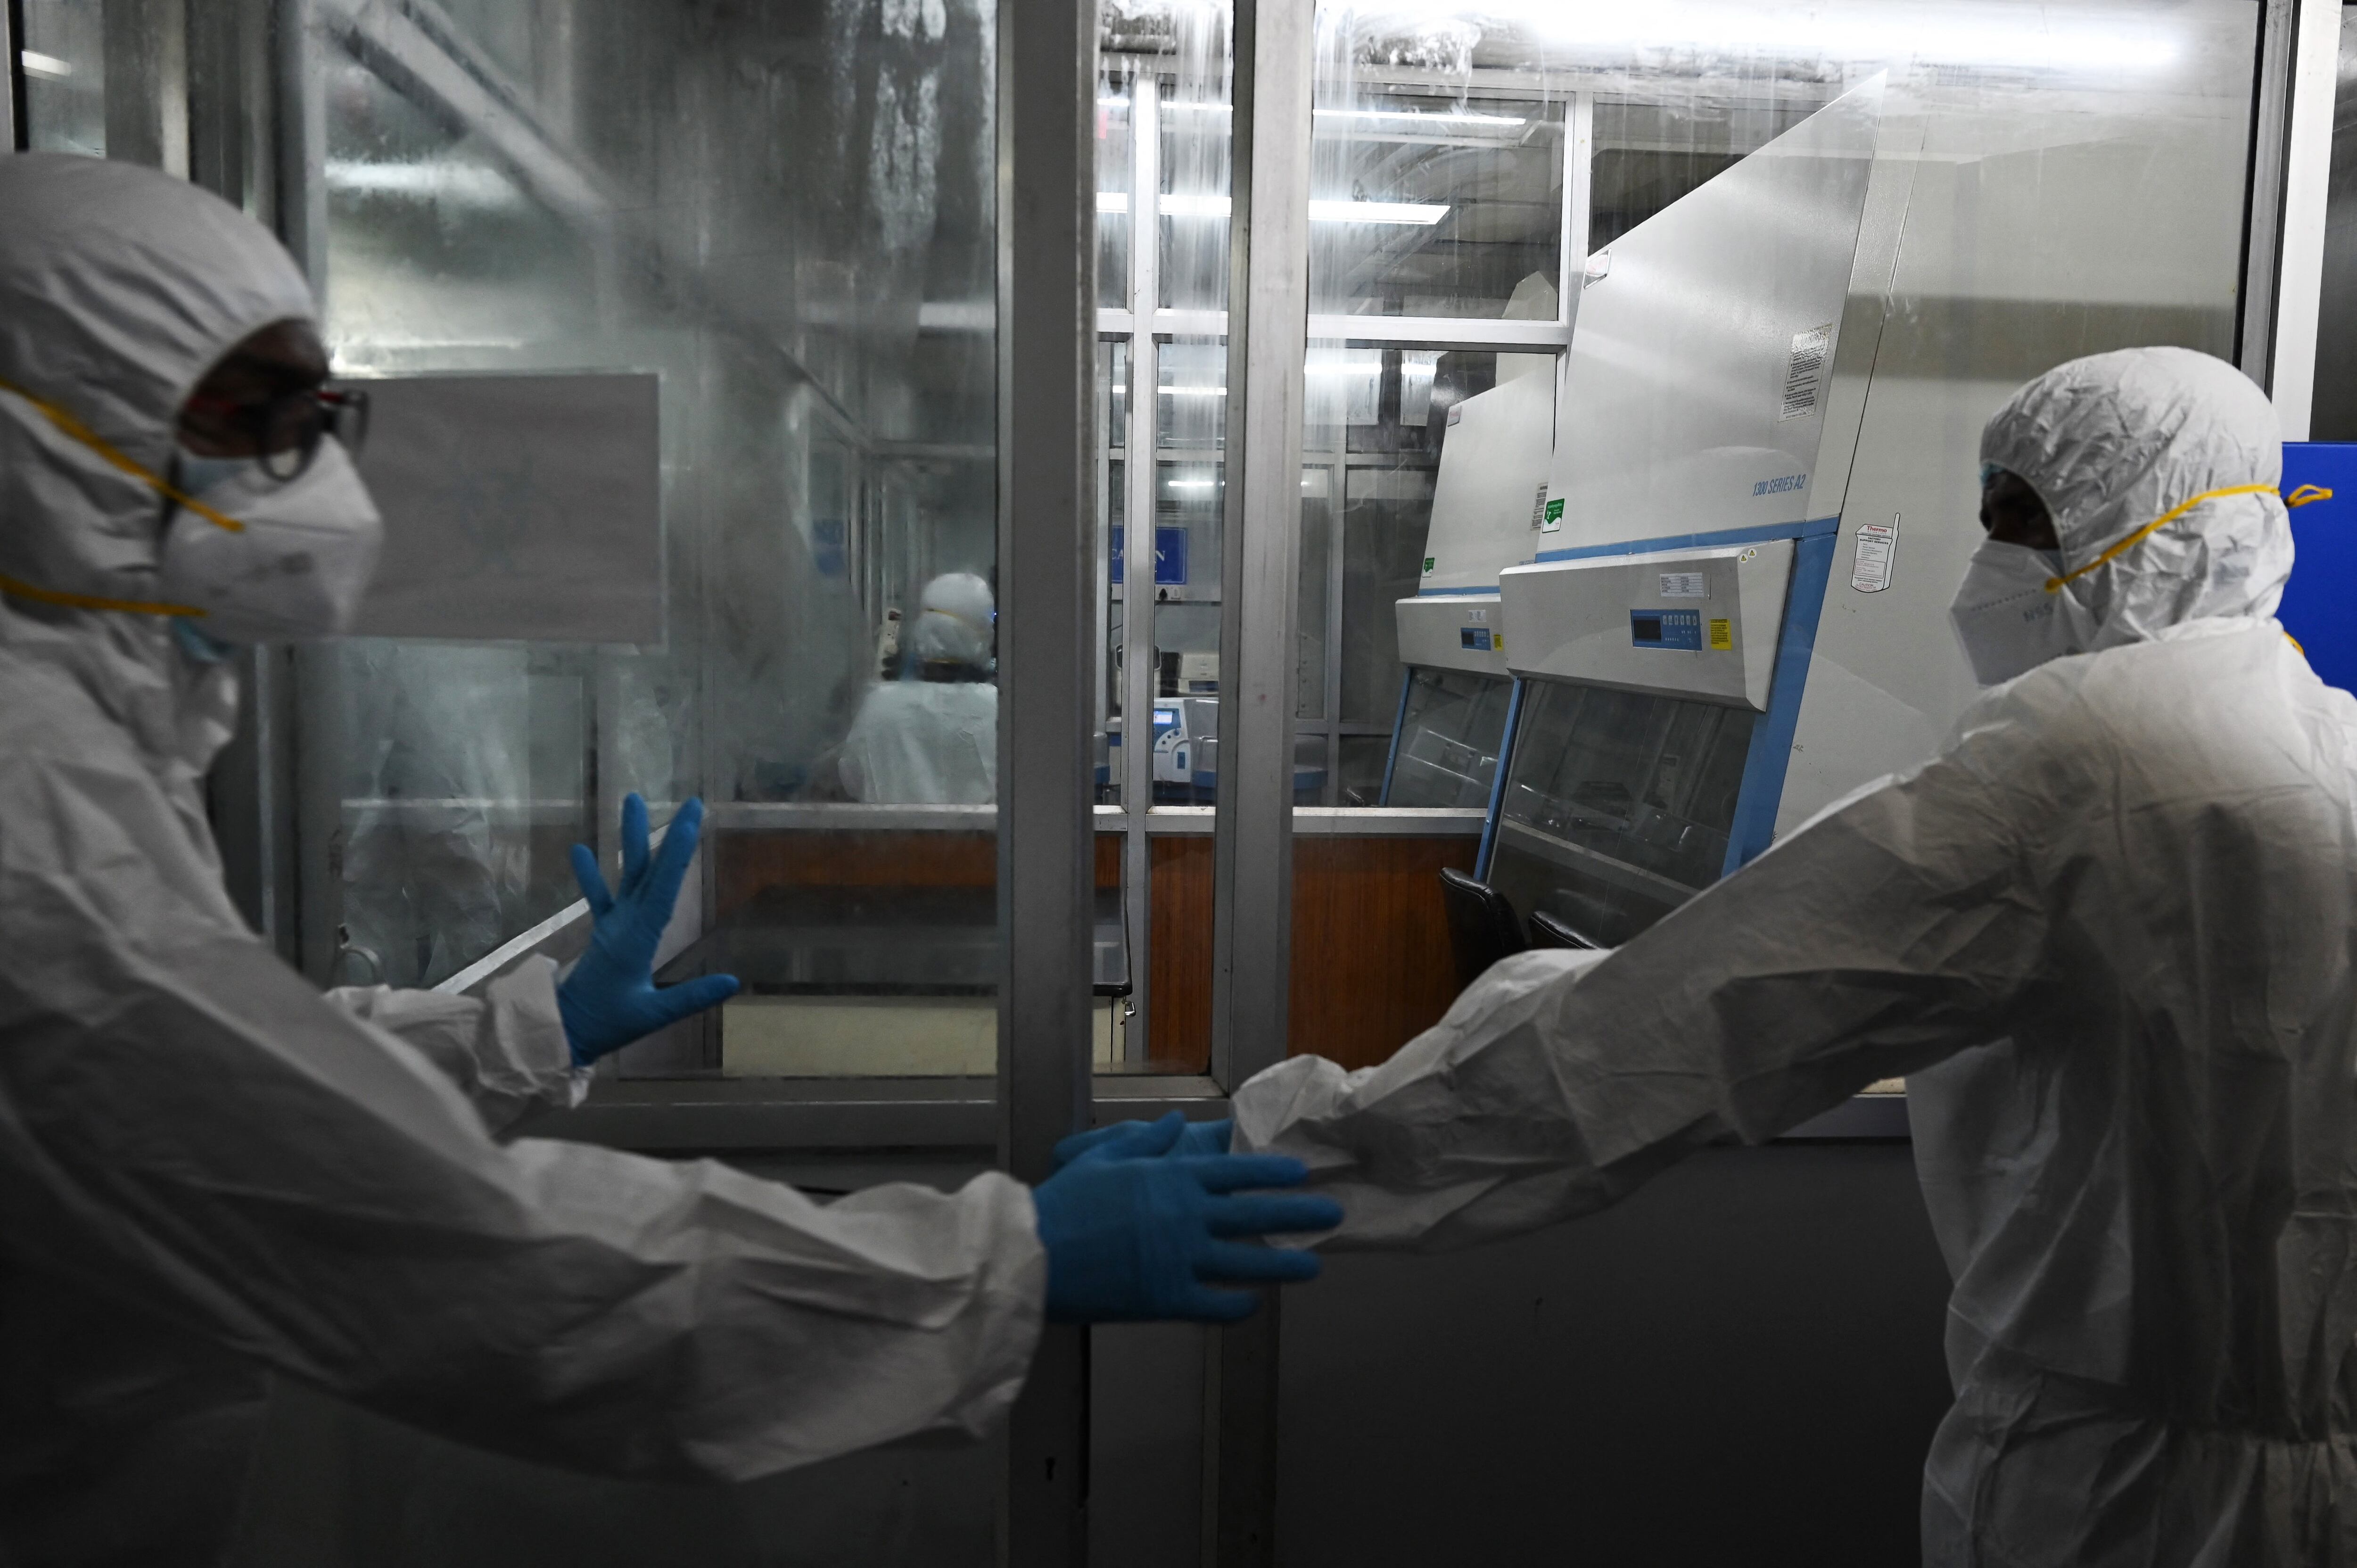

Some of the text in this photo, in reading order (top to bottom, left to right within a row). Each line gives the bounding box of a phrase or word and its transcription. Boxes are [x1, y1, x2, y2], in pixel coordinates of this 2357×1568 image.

[1753, 474, 1806, 496] 1300 SERIES A2
